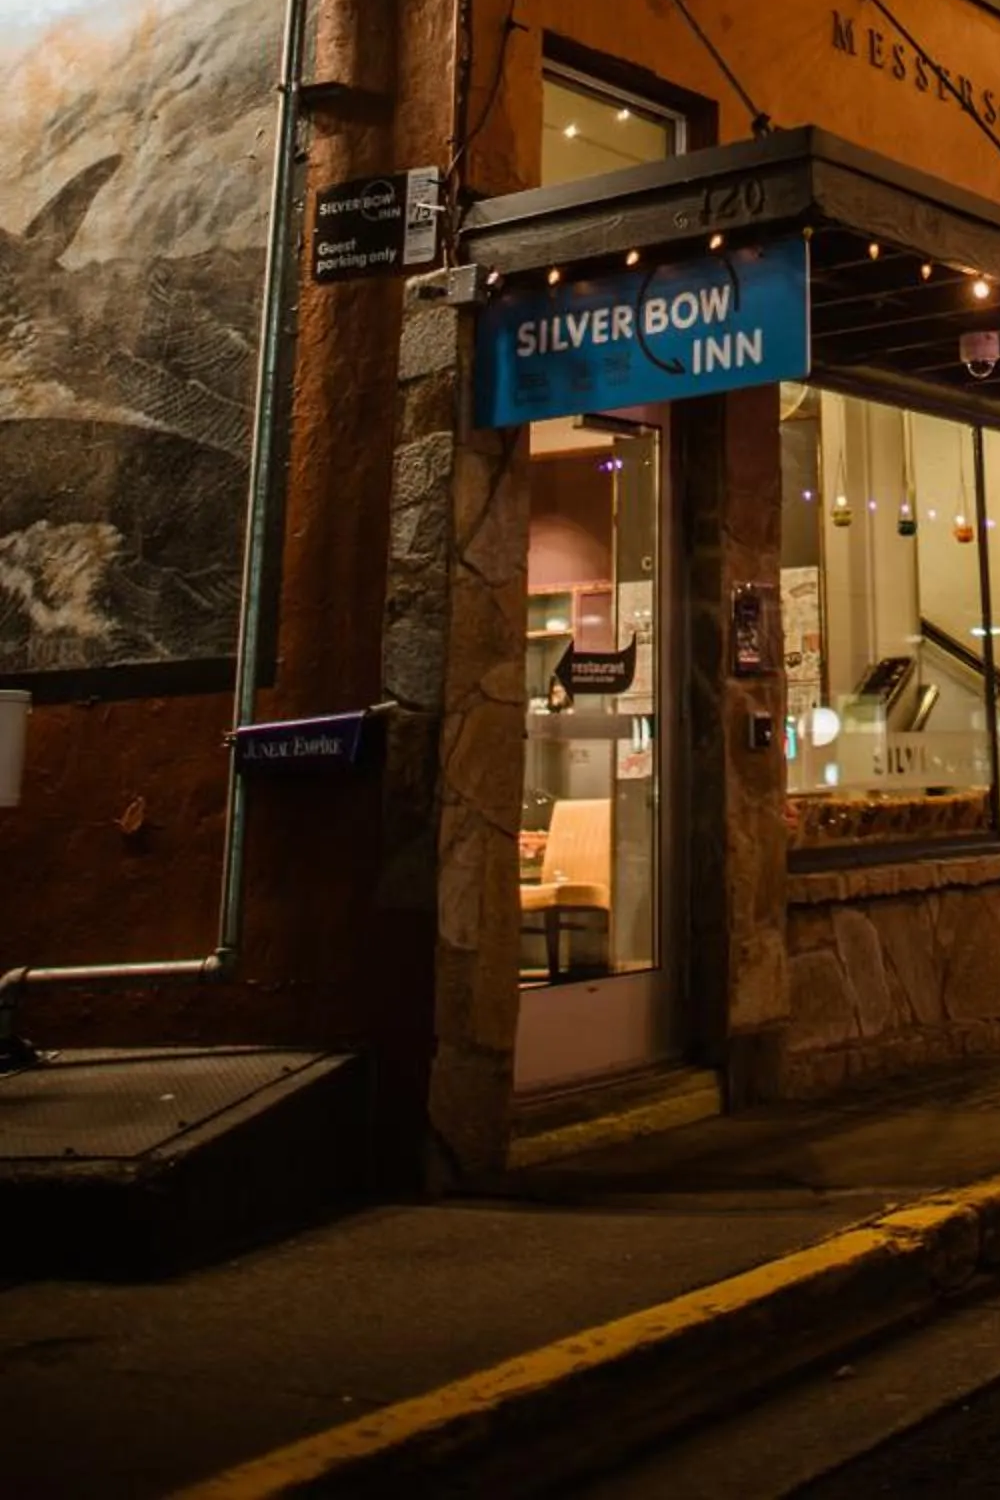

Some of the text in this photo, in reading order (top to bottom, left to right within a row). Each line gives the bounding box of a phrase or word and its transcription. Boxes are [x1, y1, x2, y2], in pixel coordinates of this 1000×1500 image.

[699, 178, 766, 226] 120
[316, 247, 397, 274] parking only
[317, 238, 356, 255] Guest
[516, 285, 731, 357] SILVER BOW
[692, 328, 763, 375] INN
[571, 661, 625, 675] restaurant
